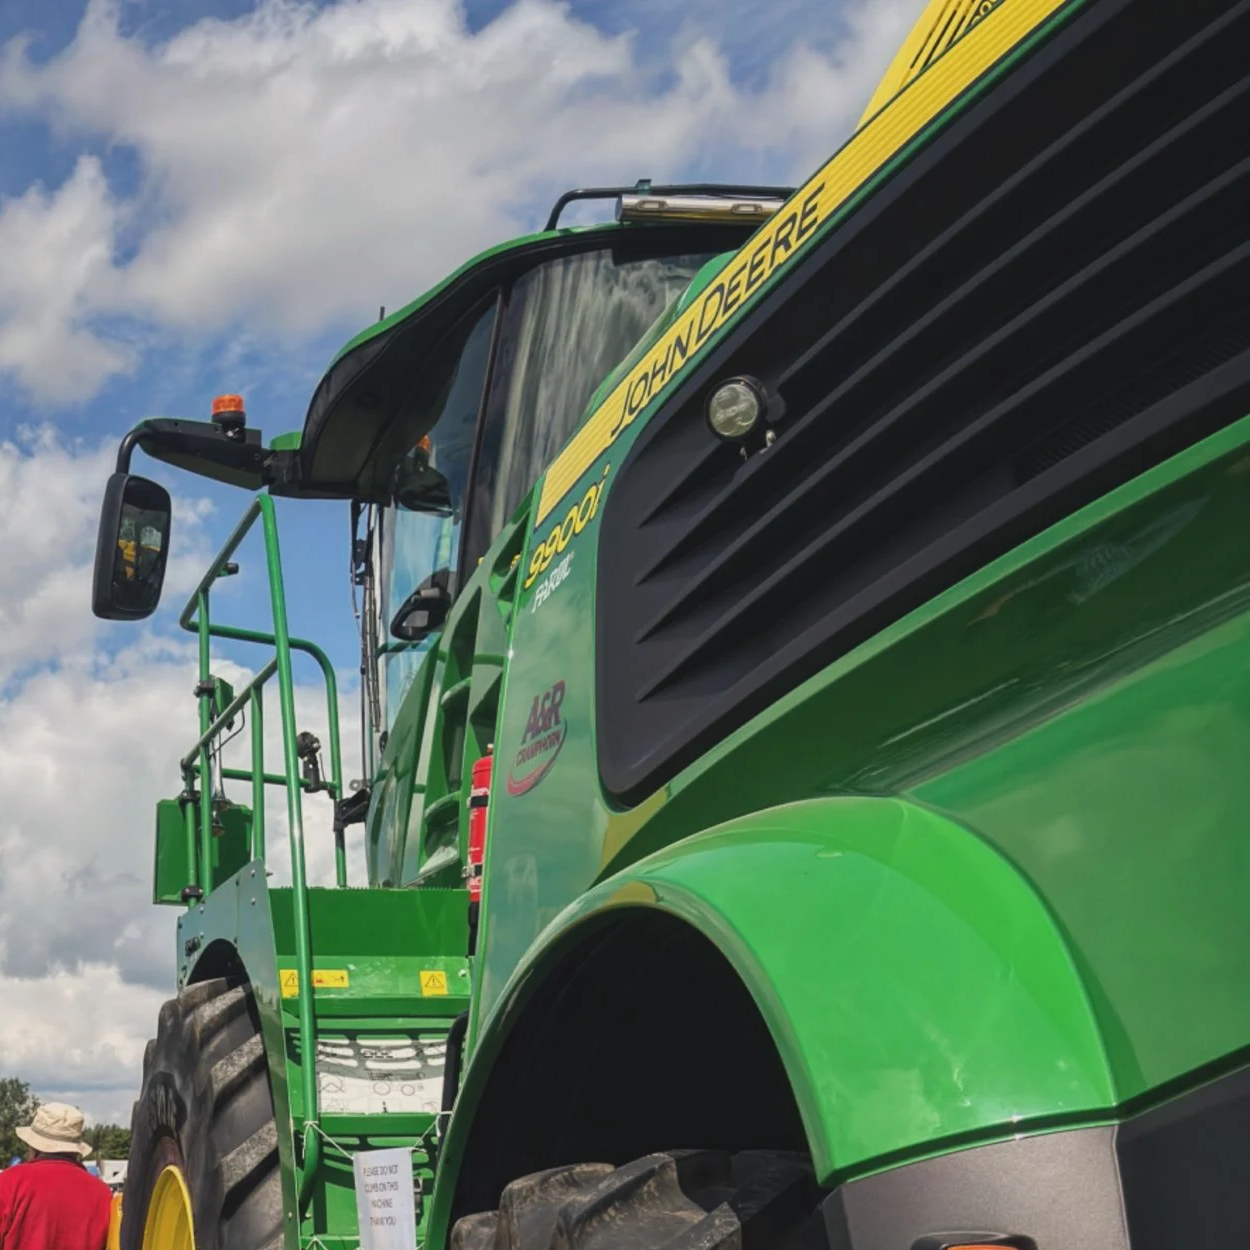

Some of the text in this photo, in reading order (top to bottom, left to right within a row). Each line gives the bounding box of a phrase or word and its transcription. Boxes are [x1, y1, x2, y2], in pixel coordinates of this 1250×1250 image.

[610, 181, 827, 439] JOHN DEERE
[523, 462, 611, 590] 9900i
[520, 680, 566, 746] A&R
[363, 1164, 398, 1176] PLEASE DO NOT
[379, 1182, 387, 1192] ON
[387, 1181, 399, 1191] THIS
[385, 1216, 396, 1226] YOU
